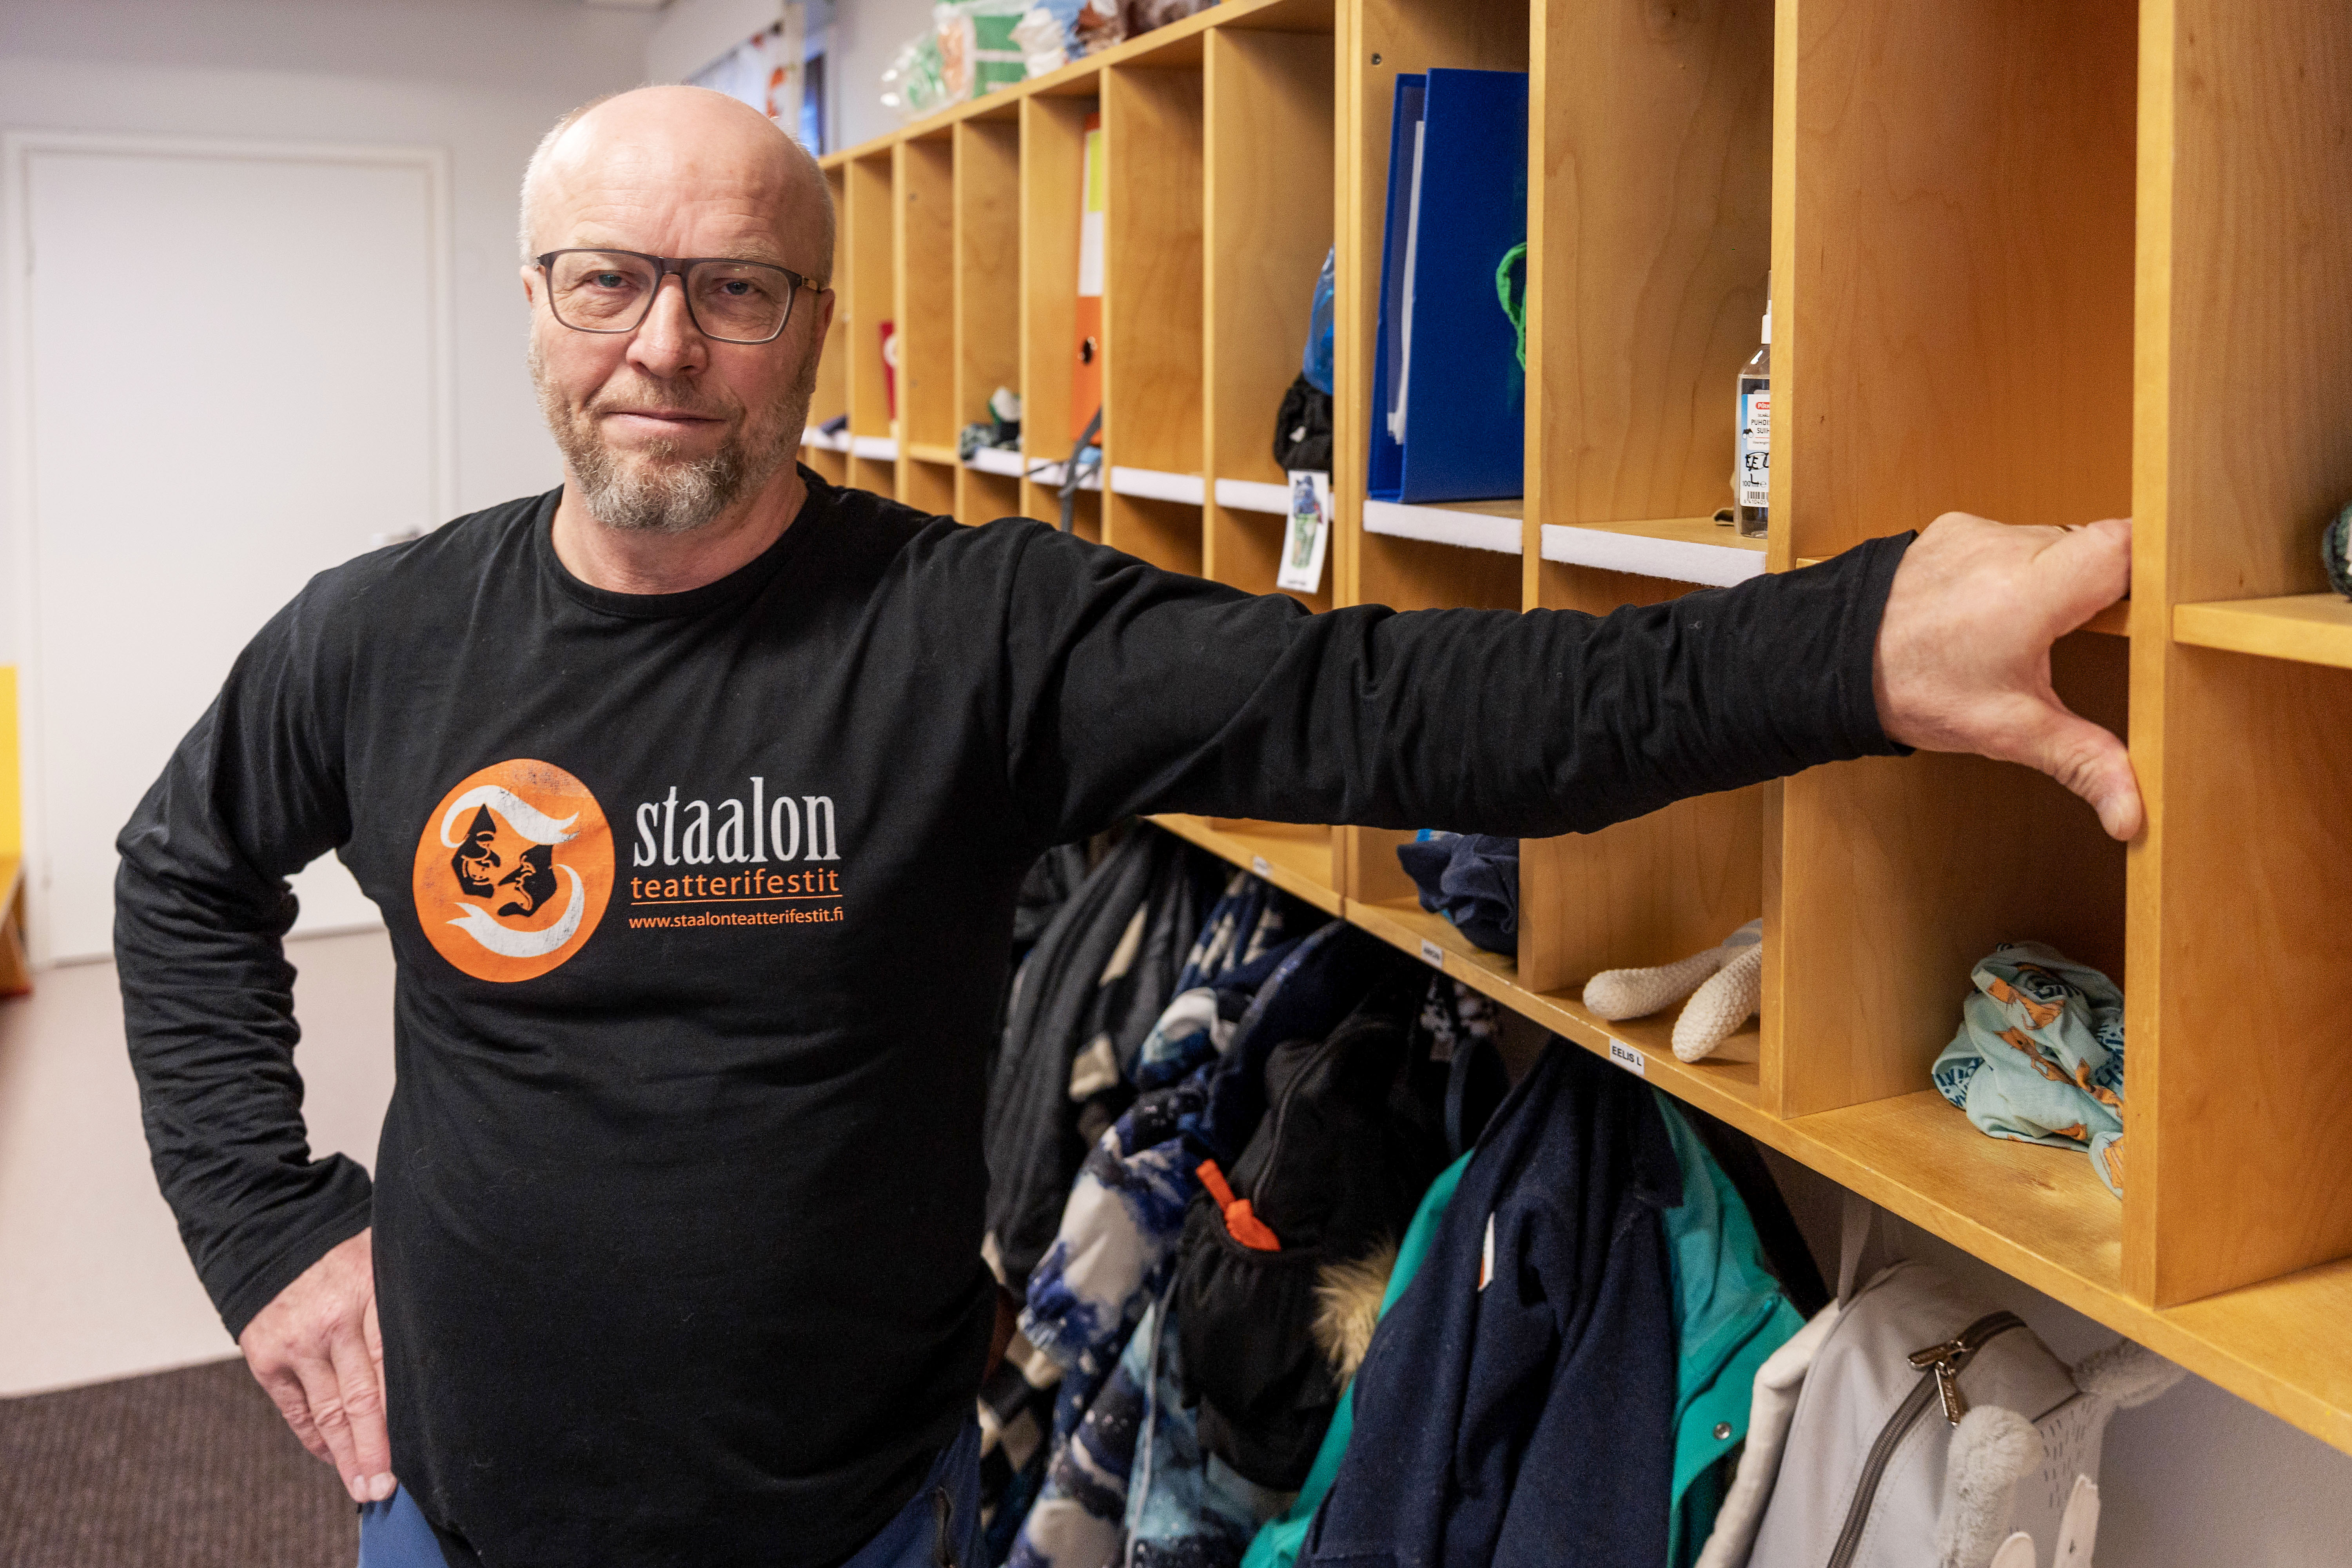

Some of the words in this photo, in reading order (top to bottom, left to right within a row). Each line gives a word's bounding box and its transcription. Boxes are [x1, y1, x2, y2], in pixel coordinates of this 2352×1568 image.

[633, 777, 841, 867] staalon
[632, 867, 840, 900] teatterifestit
[628, 907, 844, 929] www.staalonteatterifestit.fi
[1612, 1045, 1634, 1063] EELIS
[1637, 1056, 1642, 1066] L
